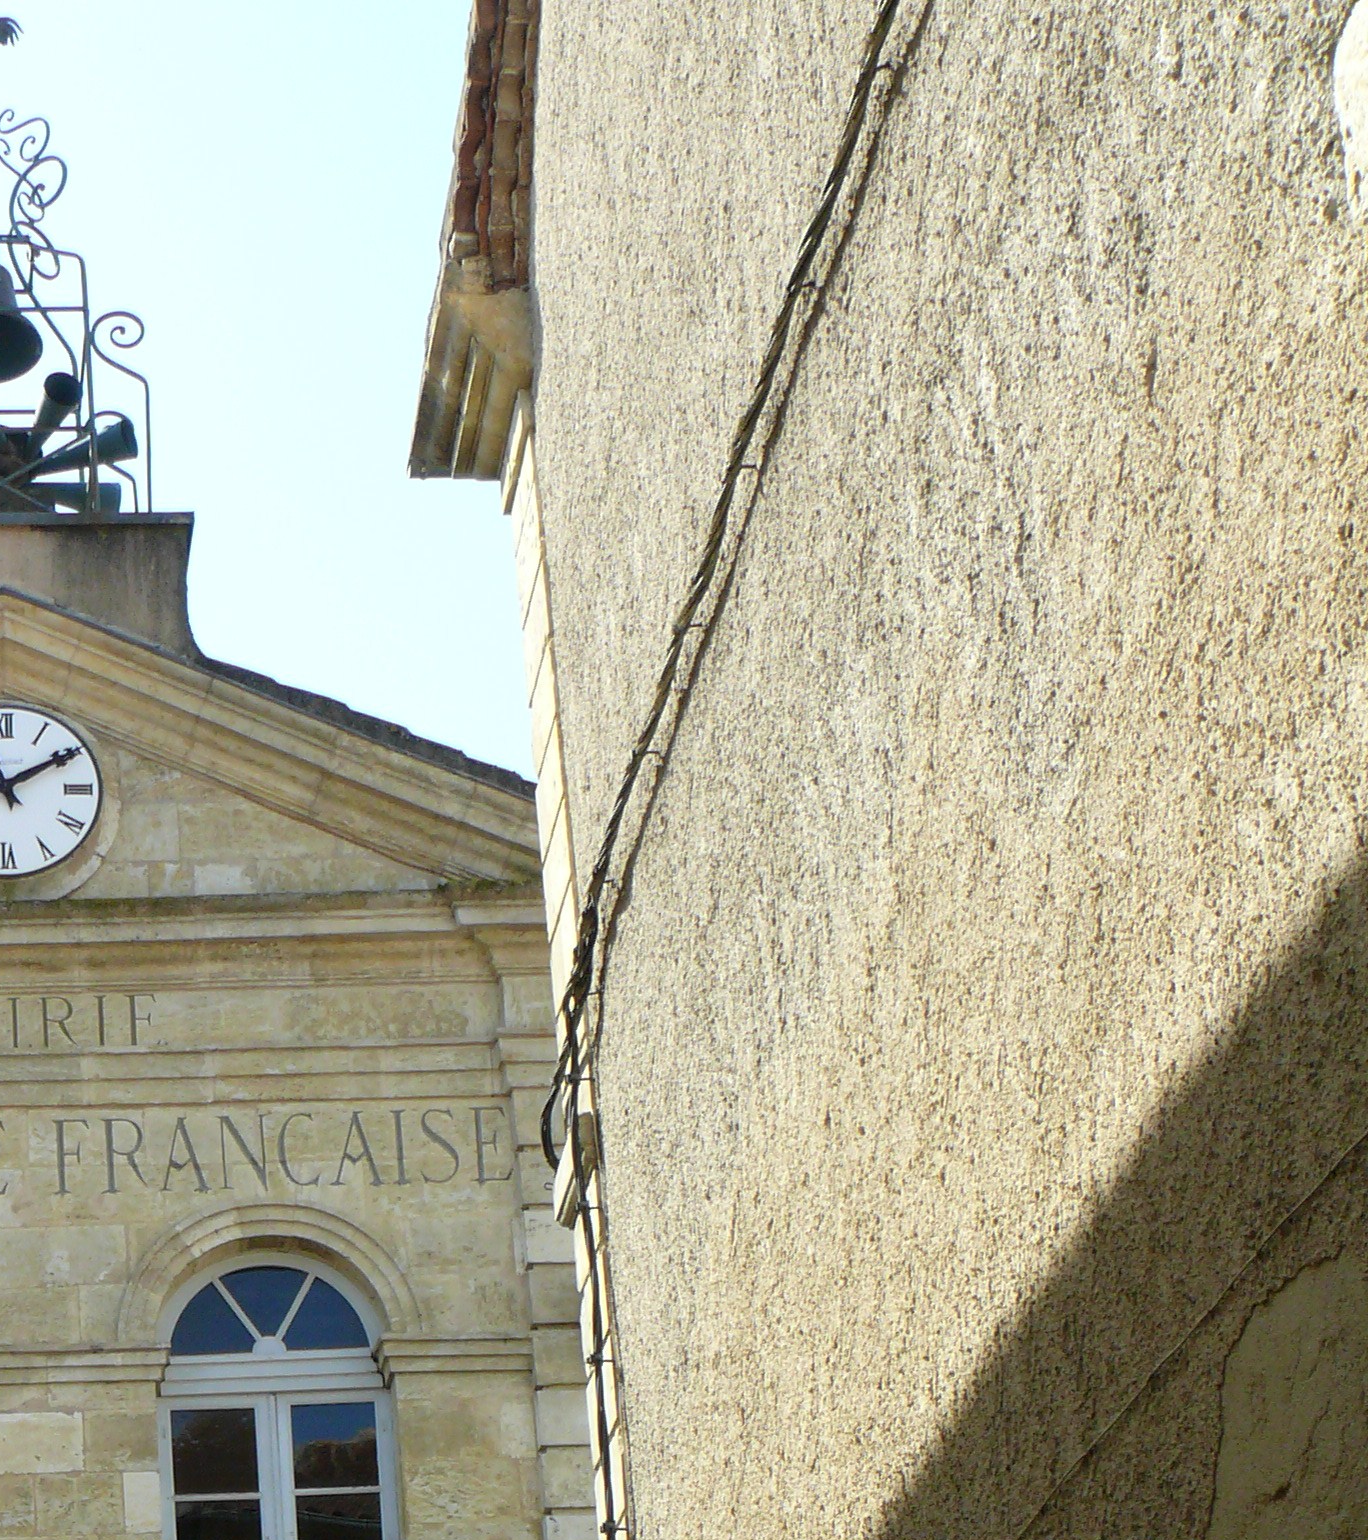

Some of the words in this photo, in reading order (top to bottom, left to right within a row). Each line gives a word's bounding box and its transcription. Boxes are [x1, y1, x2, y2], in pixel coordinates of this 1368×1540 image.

[63, 783, 93, 796] III
[0, 842, 18, 869] VI
[35, 836, 56, 862] V
